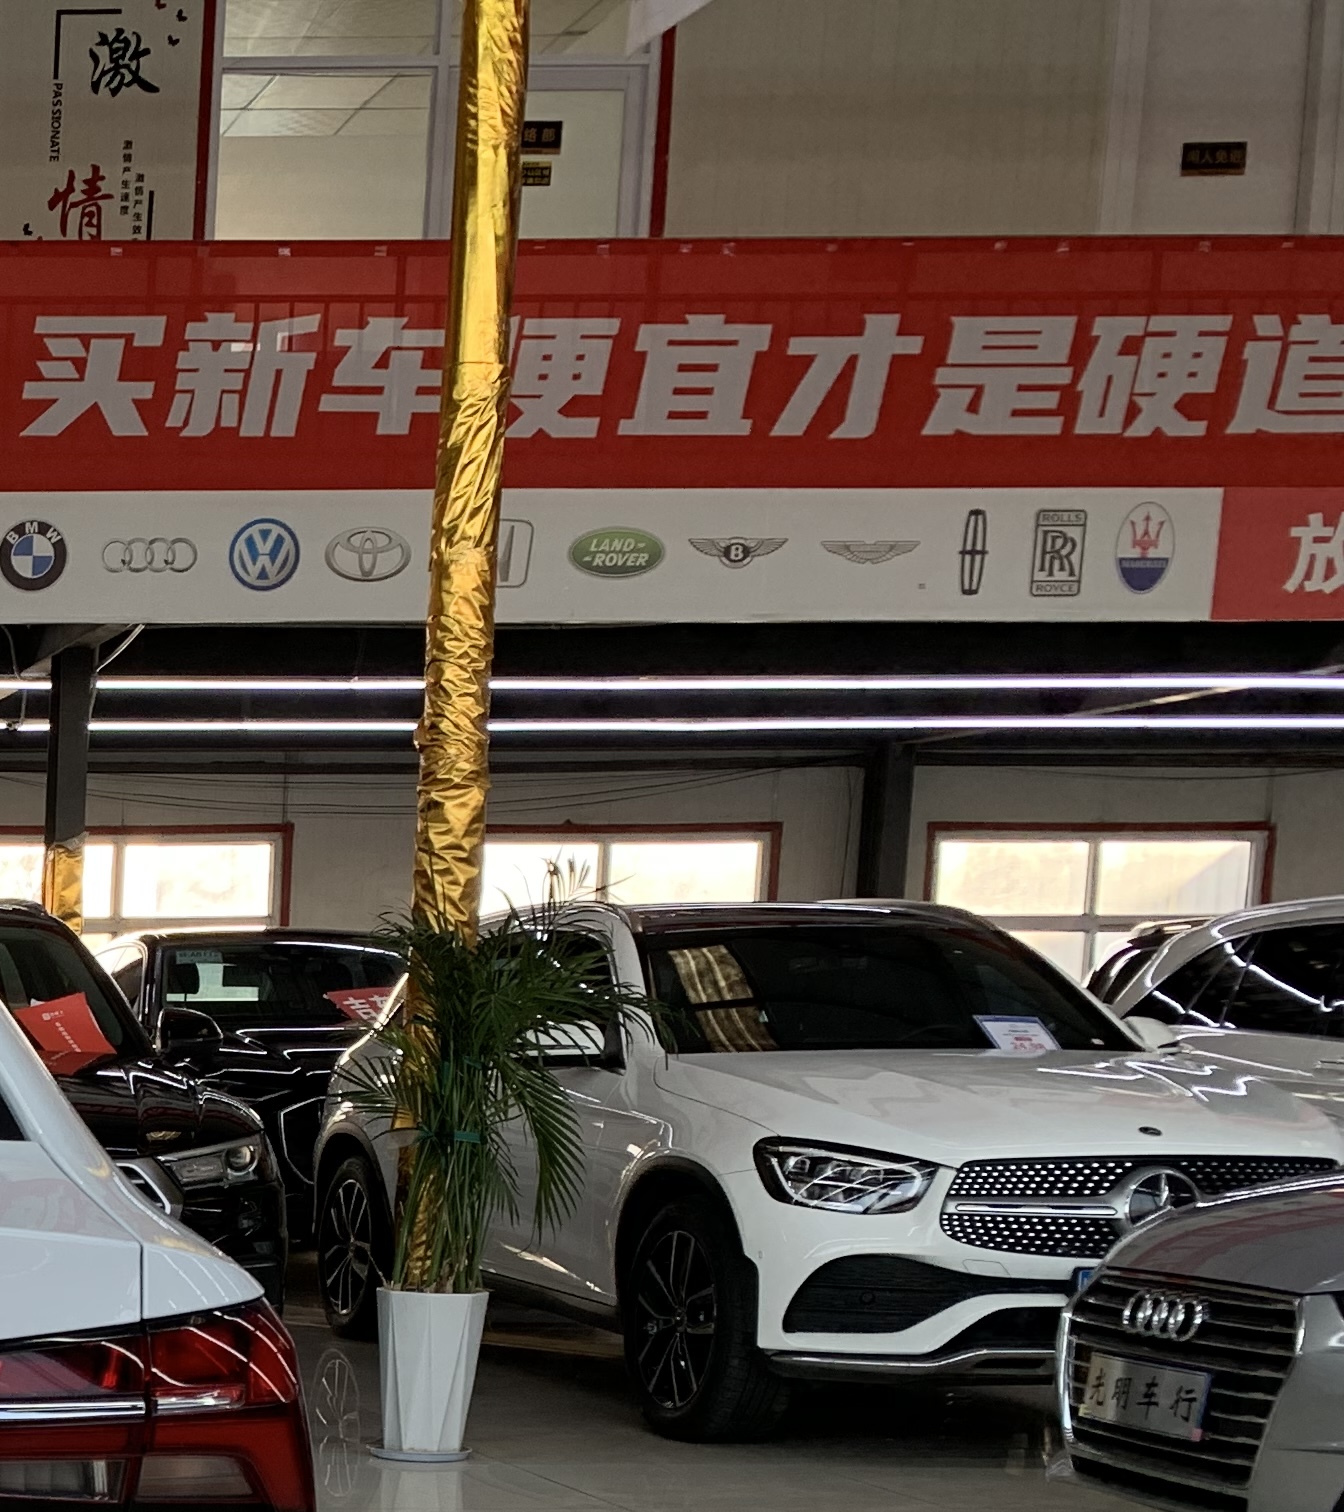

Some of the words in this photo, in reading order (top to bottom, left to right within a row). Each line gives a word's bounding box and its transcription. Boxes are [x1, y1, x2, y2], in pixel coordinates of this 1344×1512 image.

[49, 83, 63, 163] PASSIONATE
[523, 127, 556, 142] 络部
[131, 172, 145, 240] 激情产生效
[1041, 513, 1083, 524] ROLLS
[6, 521, 61, 545] BMW
[1035, 582, 1076, 594] ROYCE
